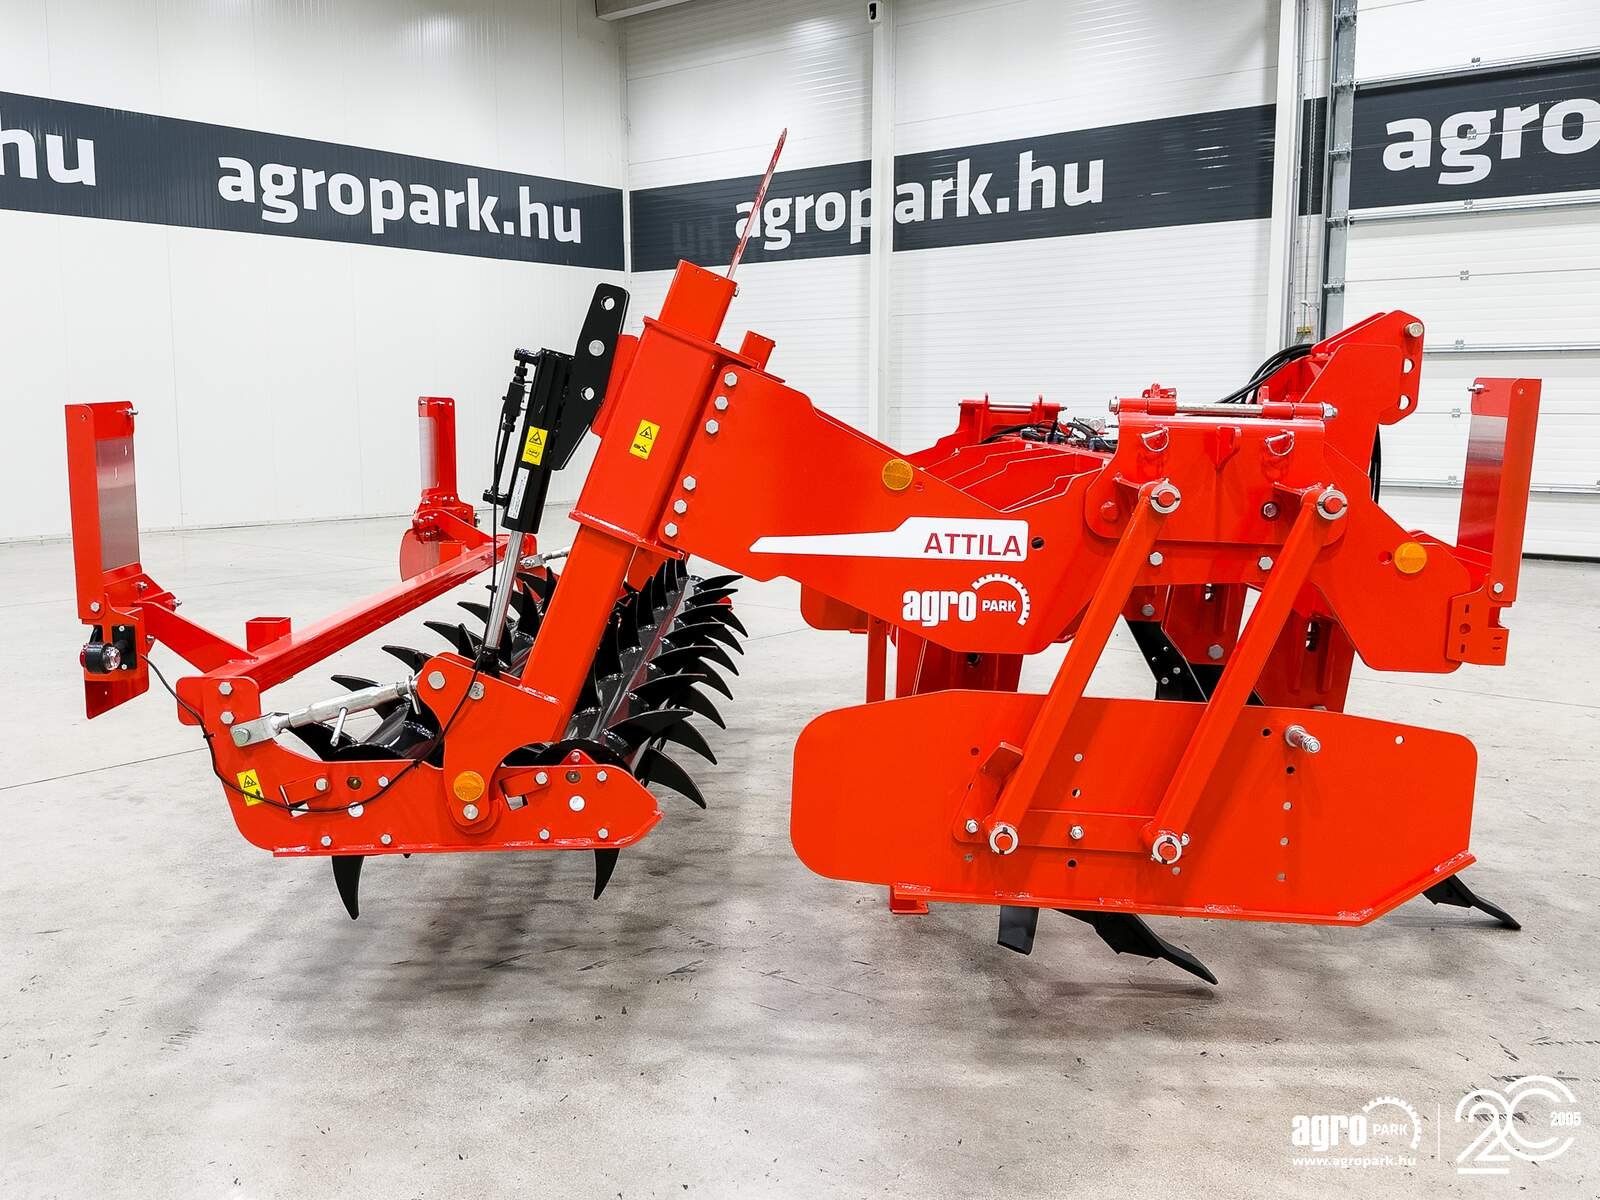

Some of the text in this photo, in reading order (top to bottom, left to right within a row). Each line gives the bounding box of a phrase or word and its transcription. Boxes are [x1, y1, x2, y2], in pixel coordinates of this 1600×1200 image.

[217, 155, 581, 244] agropark.hu
[735, 150, 1104, 251] agropark.hu
[923, 532, 1022, 557] ATTILA
[902, 589, 1017, 627] agro PARK
